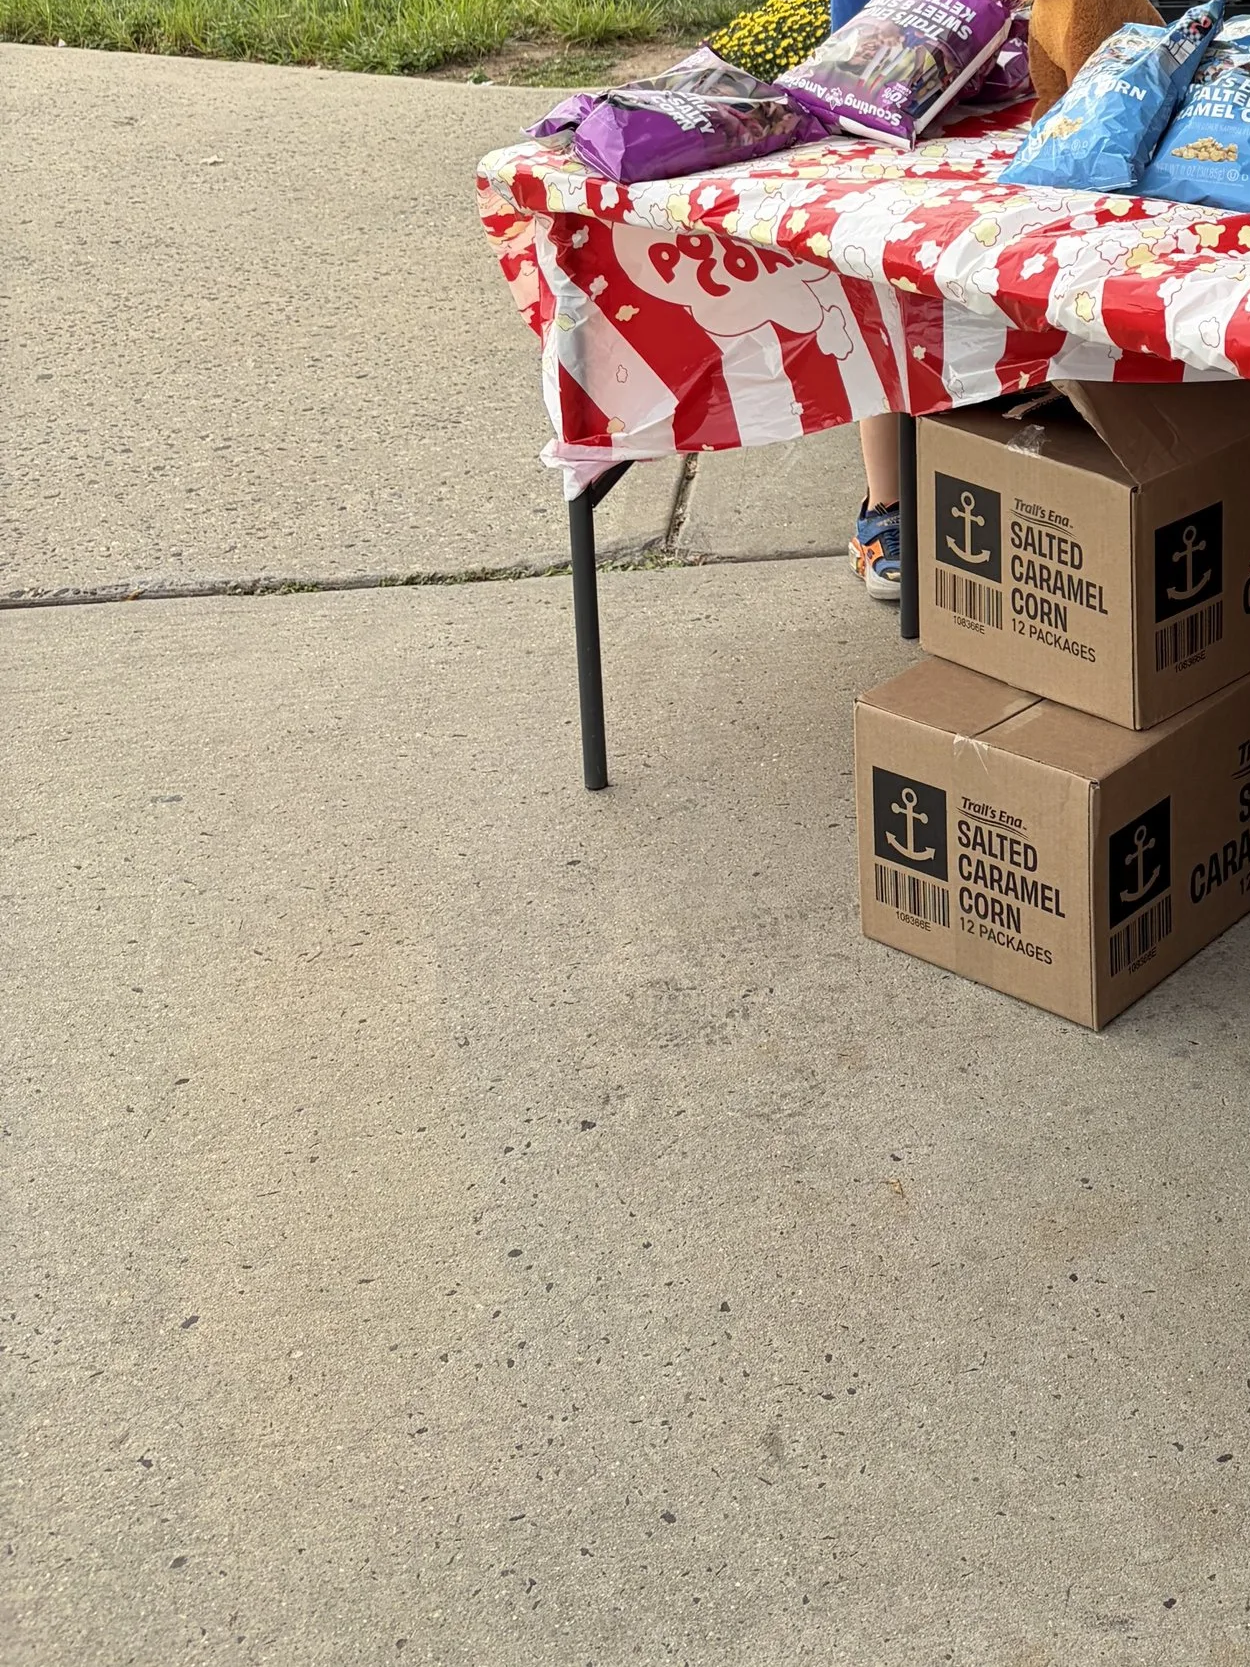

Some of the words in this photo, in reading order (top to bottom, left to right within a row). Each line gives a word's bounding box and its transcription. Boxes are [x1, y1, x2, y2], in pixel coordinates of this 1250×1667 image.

[894, 10, 945, 41] Trail's
[913, 8, 973, 42] SWEET
[651, 95, 697, 133] CORN
[664, 97, 716, 135] SALTY
[844, 94, 903, 126] Scouting
[882, 86, 910, 108] 70%
[1014, 498, 1046, 520] Trail's
[1010, 521, 1083, 570] SALTED
[1010, 554, 1109, 615] CARAMEL
[953, 615, 986, 635] 108366E
[1011, 587, 1068, 633] CORN
[1012, 618, 1026, 635] 12
[1029, 624, 1096, 663] PACKAGES
[961, 796, 997, 819] Trail's
[957, 819, 1038, 873] SALTED
[958, 853, 1066, 919] CARAMEL
[896, 910, 932, 932] 108366E
[959, 886, 1021, 934] CORN
[960, 917, 975, 935] 12
[979, 923, 1053, 965] PACKAGES
